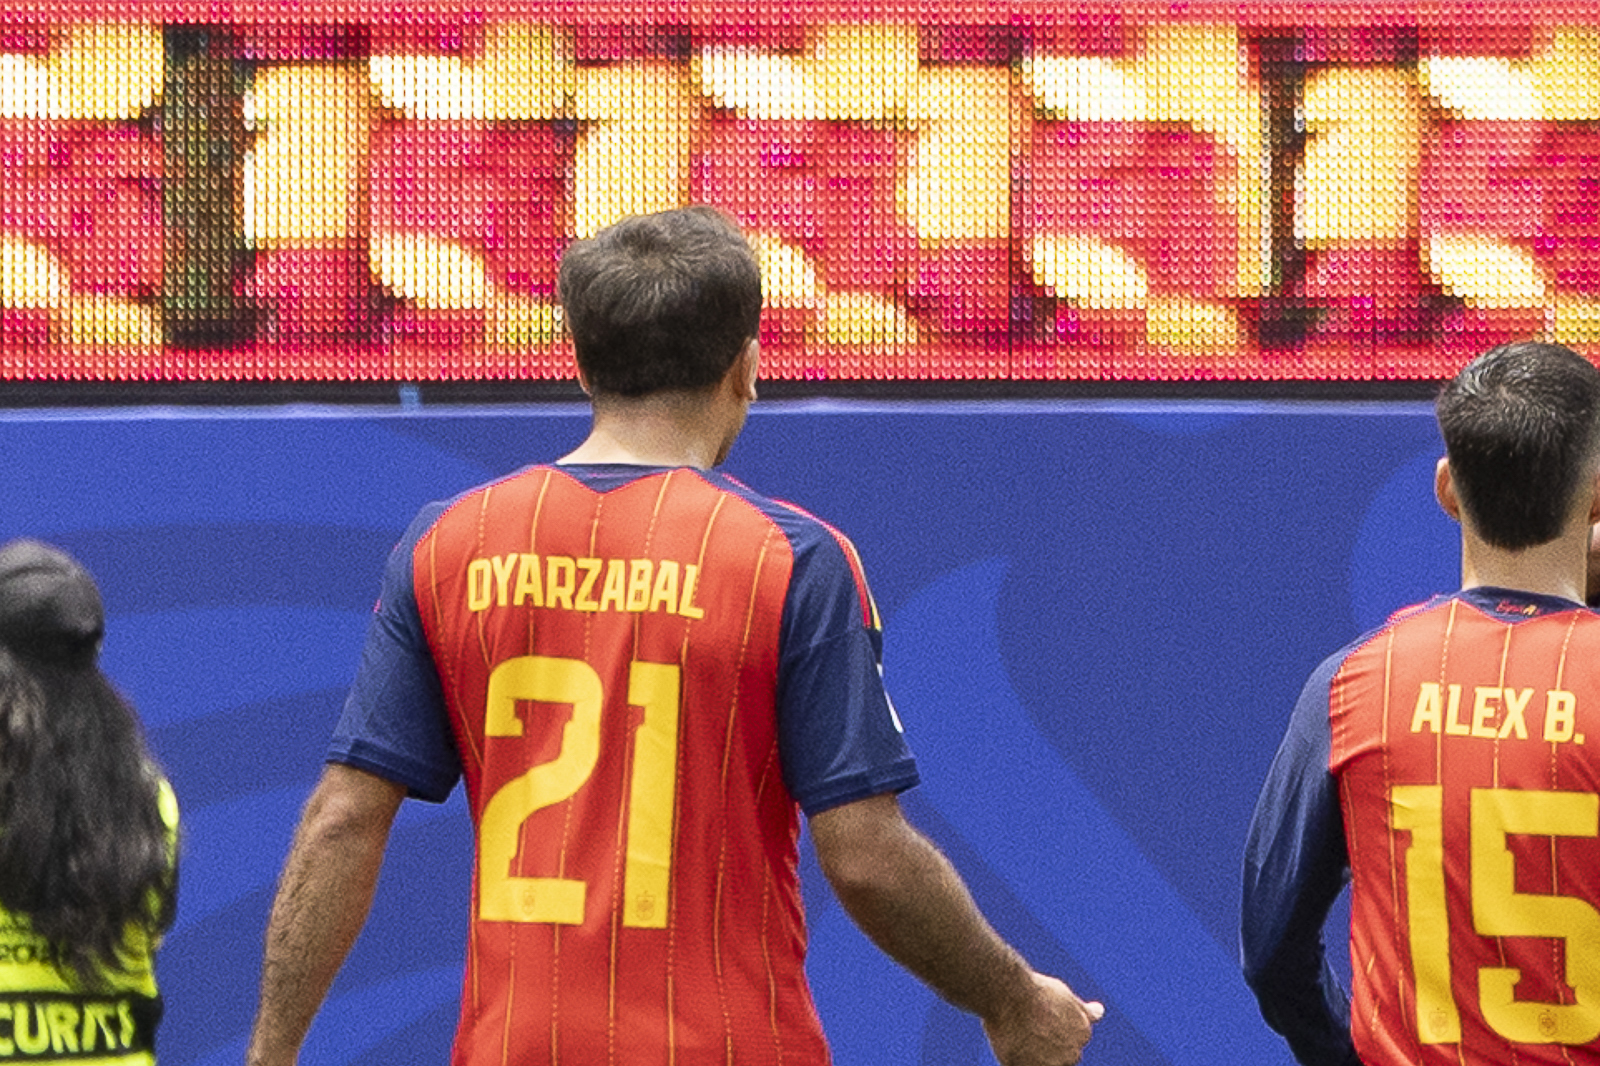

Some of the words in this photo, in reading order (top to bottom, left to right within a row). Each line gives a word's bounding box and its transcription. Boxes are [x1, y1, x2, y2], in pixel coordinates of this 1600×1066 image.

[467, 553, 704, 619] OYARZABAL
[1410, 681, 1535, 741] ALEX
[1543, 689, 1585, 745] B.
[479, 655, 681, 930] 21
